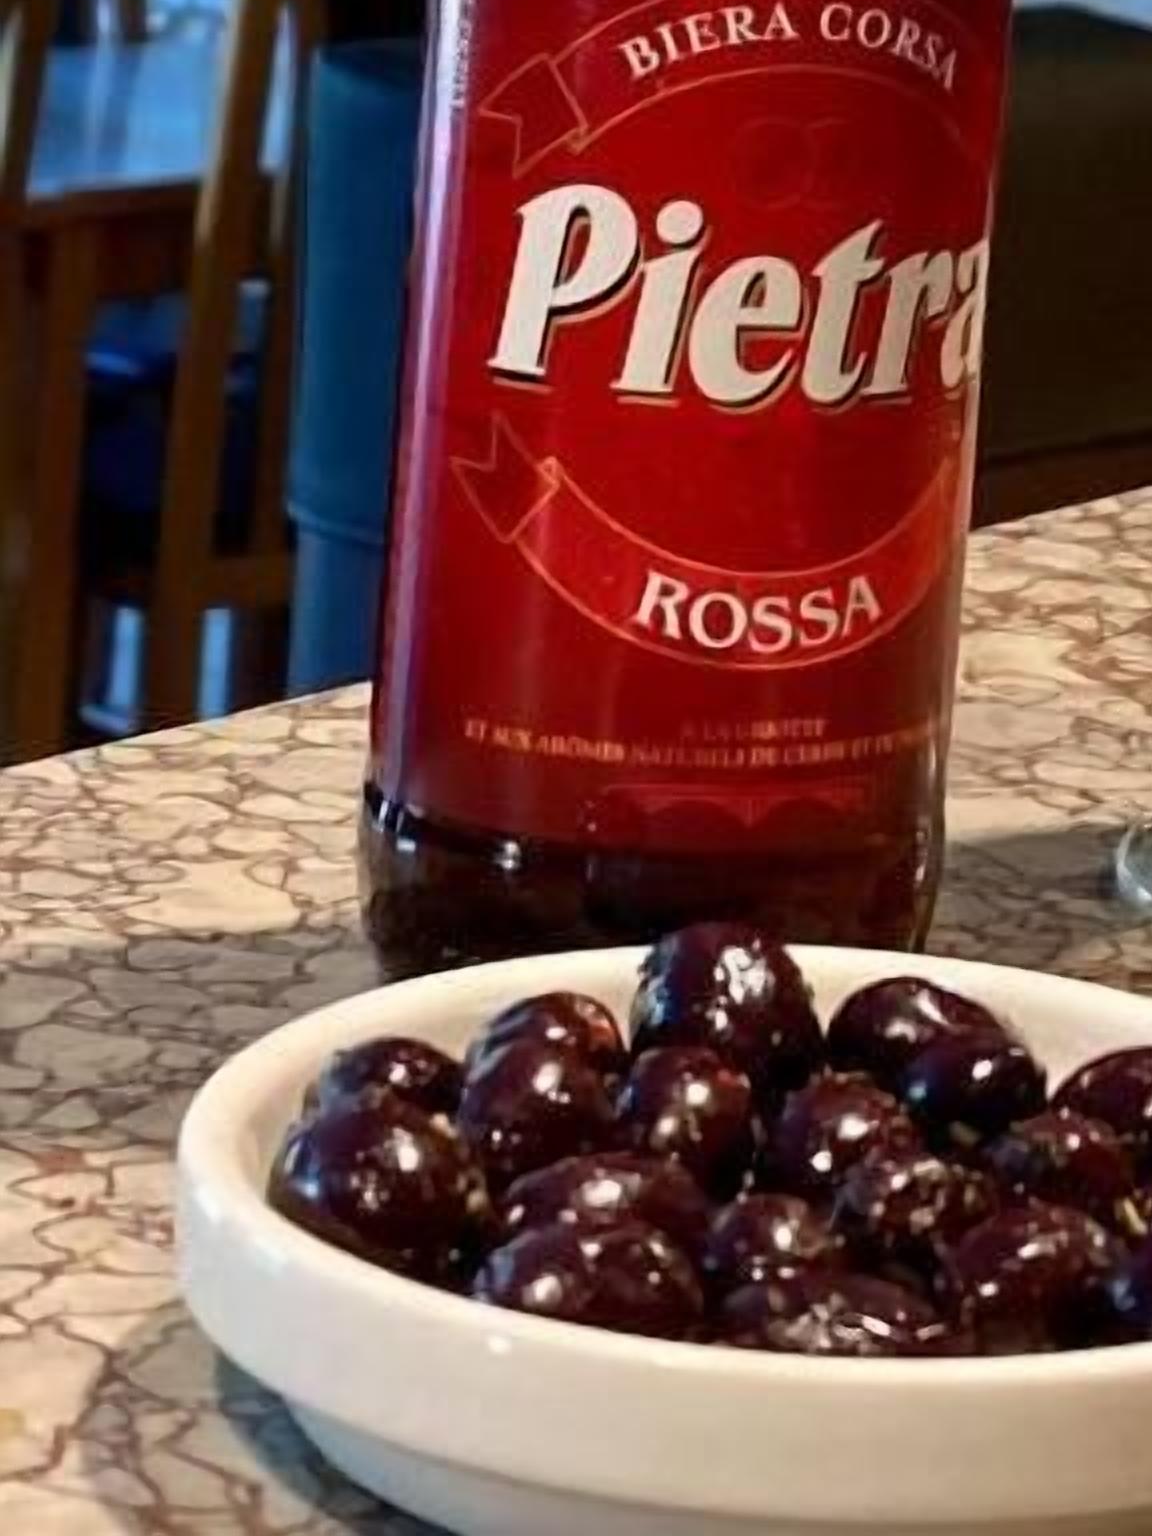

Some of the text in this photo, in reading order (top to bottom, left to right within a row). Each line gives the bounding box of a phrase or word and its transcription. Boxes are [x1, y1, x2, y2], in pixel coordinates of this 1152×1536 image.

[619, 1, 959, 91] BIERA CORSA
[487, 183, 989, 410] Pietra
[632, 569, 882, 654] ROSSA
